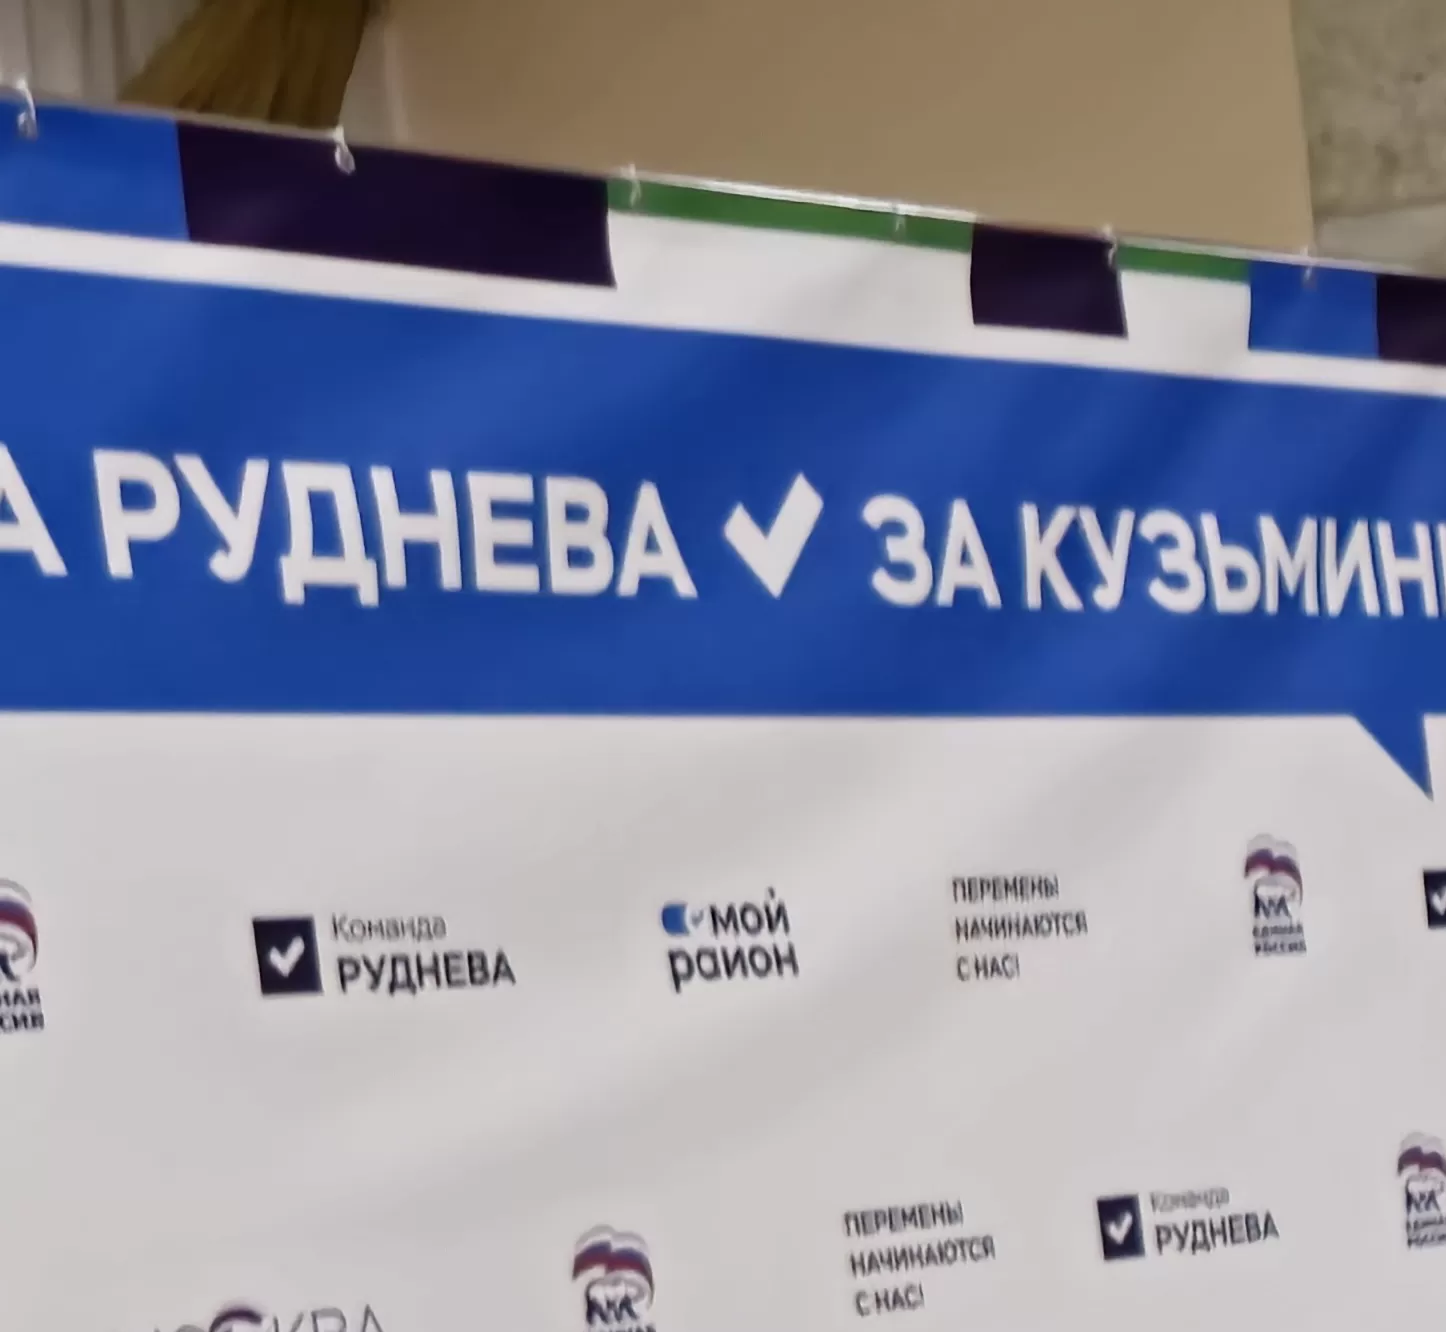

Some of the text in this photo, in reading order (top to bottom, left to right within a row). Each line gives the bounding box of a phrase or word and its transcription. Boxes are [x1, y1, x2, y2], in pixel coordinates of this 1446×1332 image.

[92, 448, 698, 607] РУДНЕВА
[862, 493, 1000, 607] ЗА
[331, 913, 447, 941] Команда
[709, 886, 790, 938] мой
[337, 948, 517, 997] РУДНЕВА
[667, 940, 799, 994] район
[1154, 1210, 1280, 1256] РУДНЕВА
